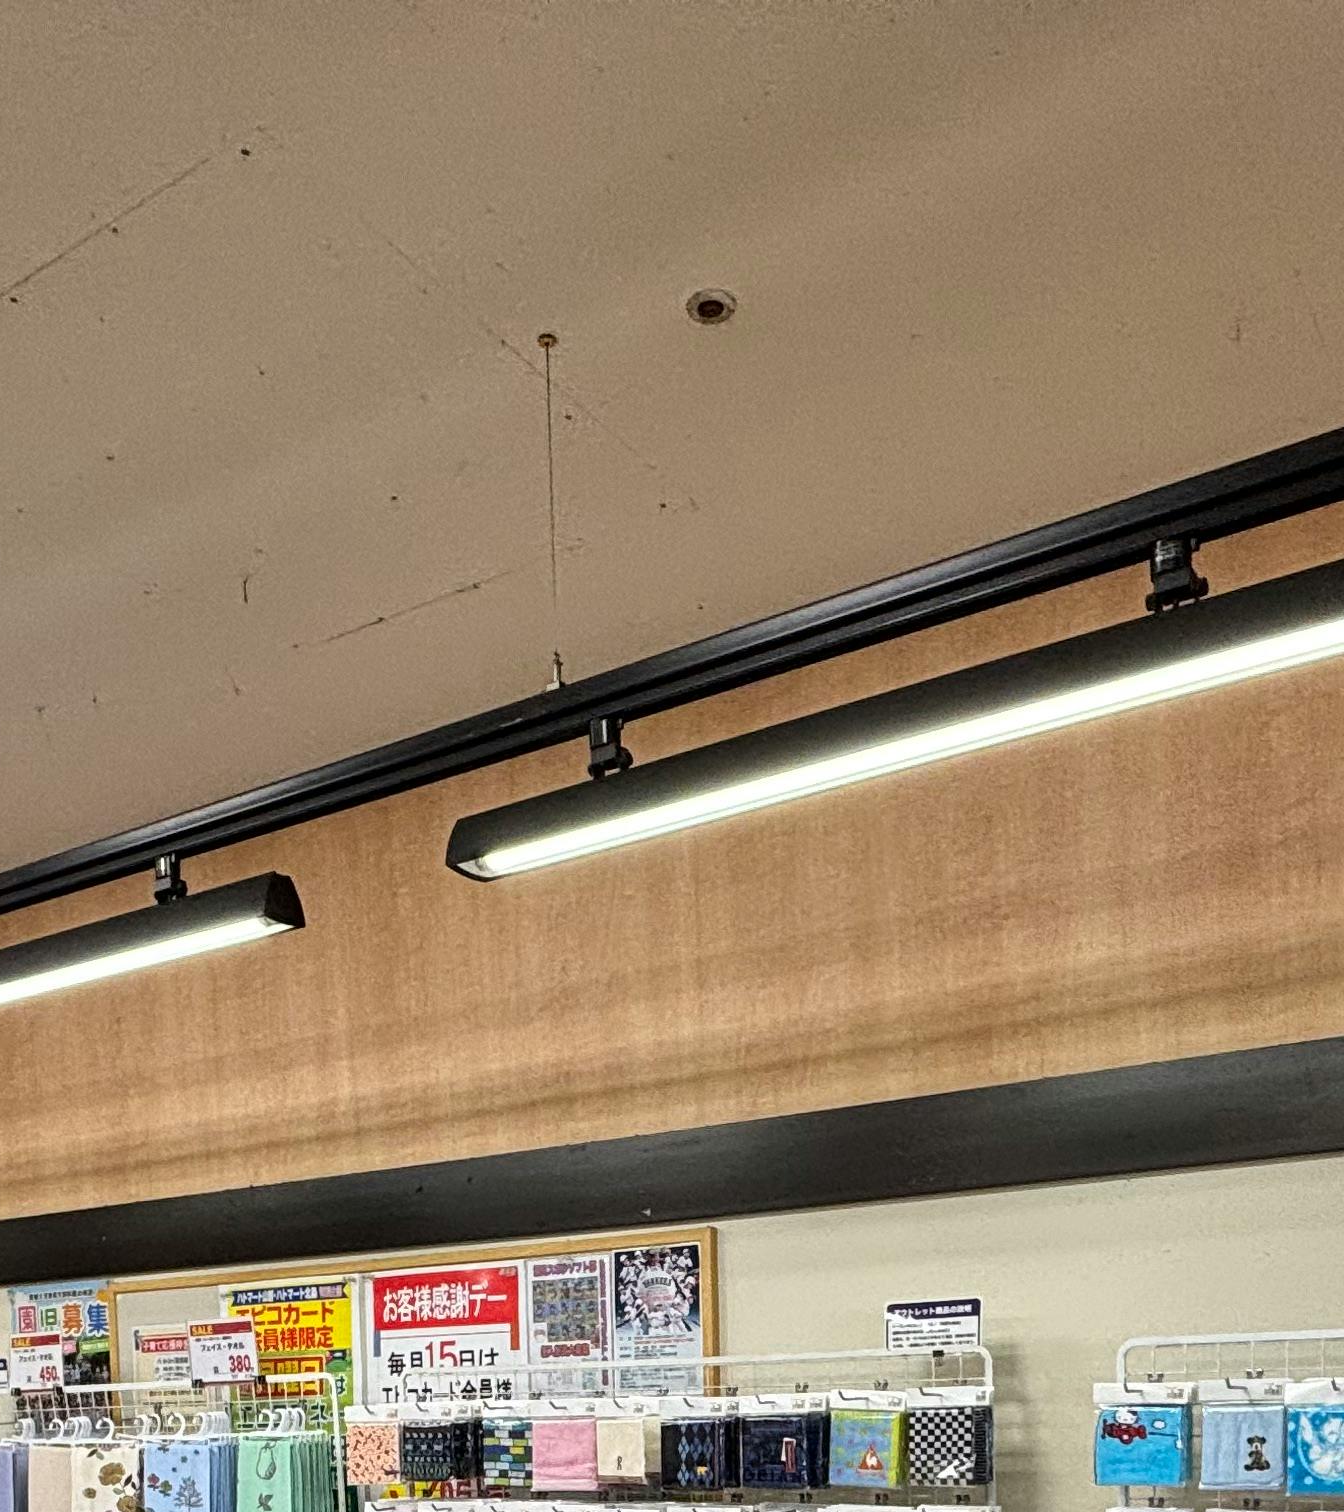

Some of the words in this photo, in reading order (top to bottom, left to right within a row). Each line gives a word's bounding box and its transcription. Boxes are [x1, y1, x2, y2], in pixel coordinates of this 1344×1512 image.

[383, 1279, 507, 1323] お客様感謝デー
